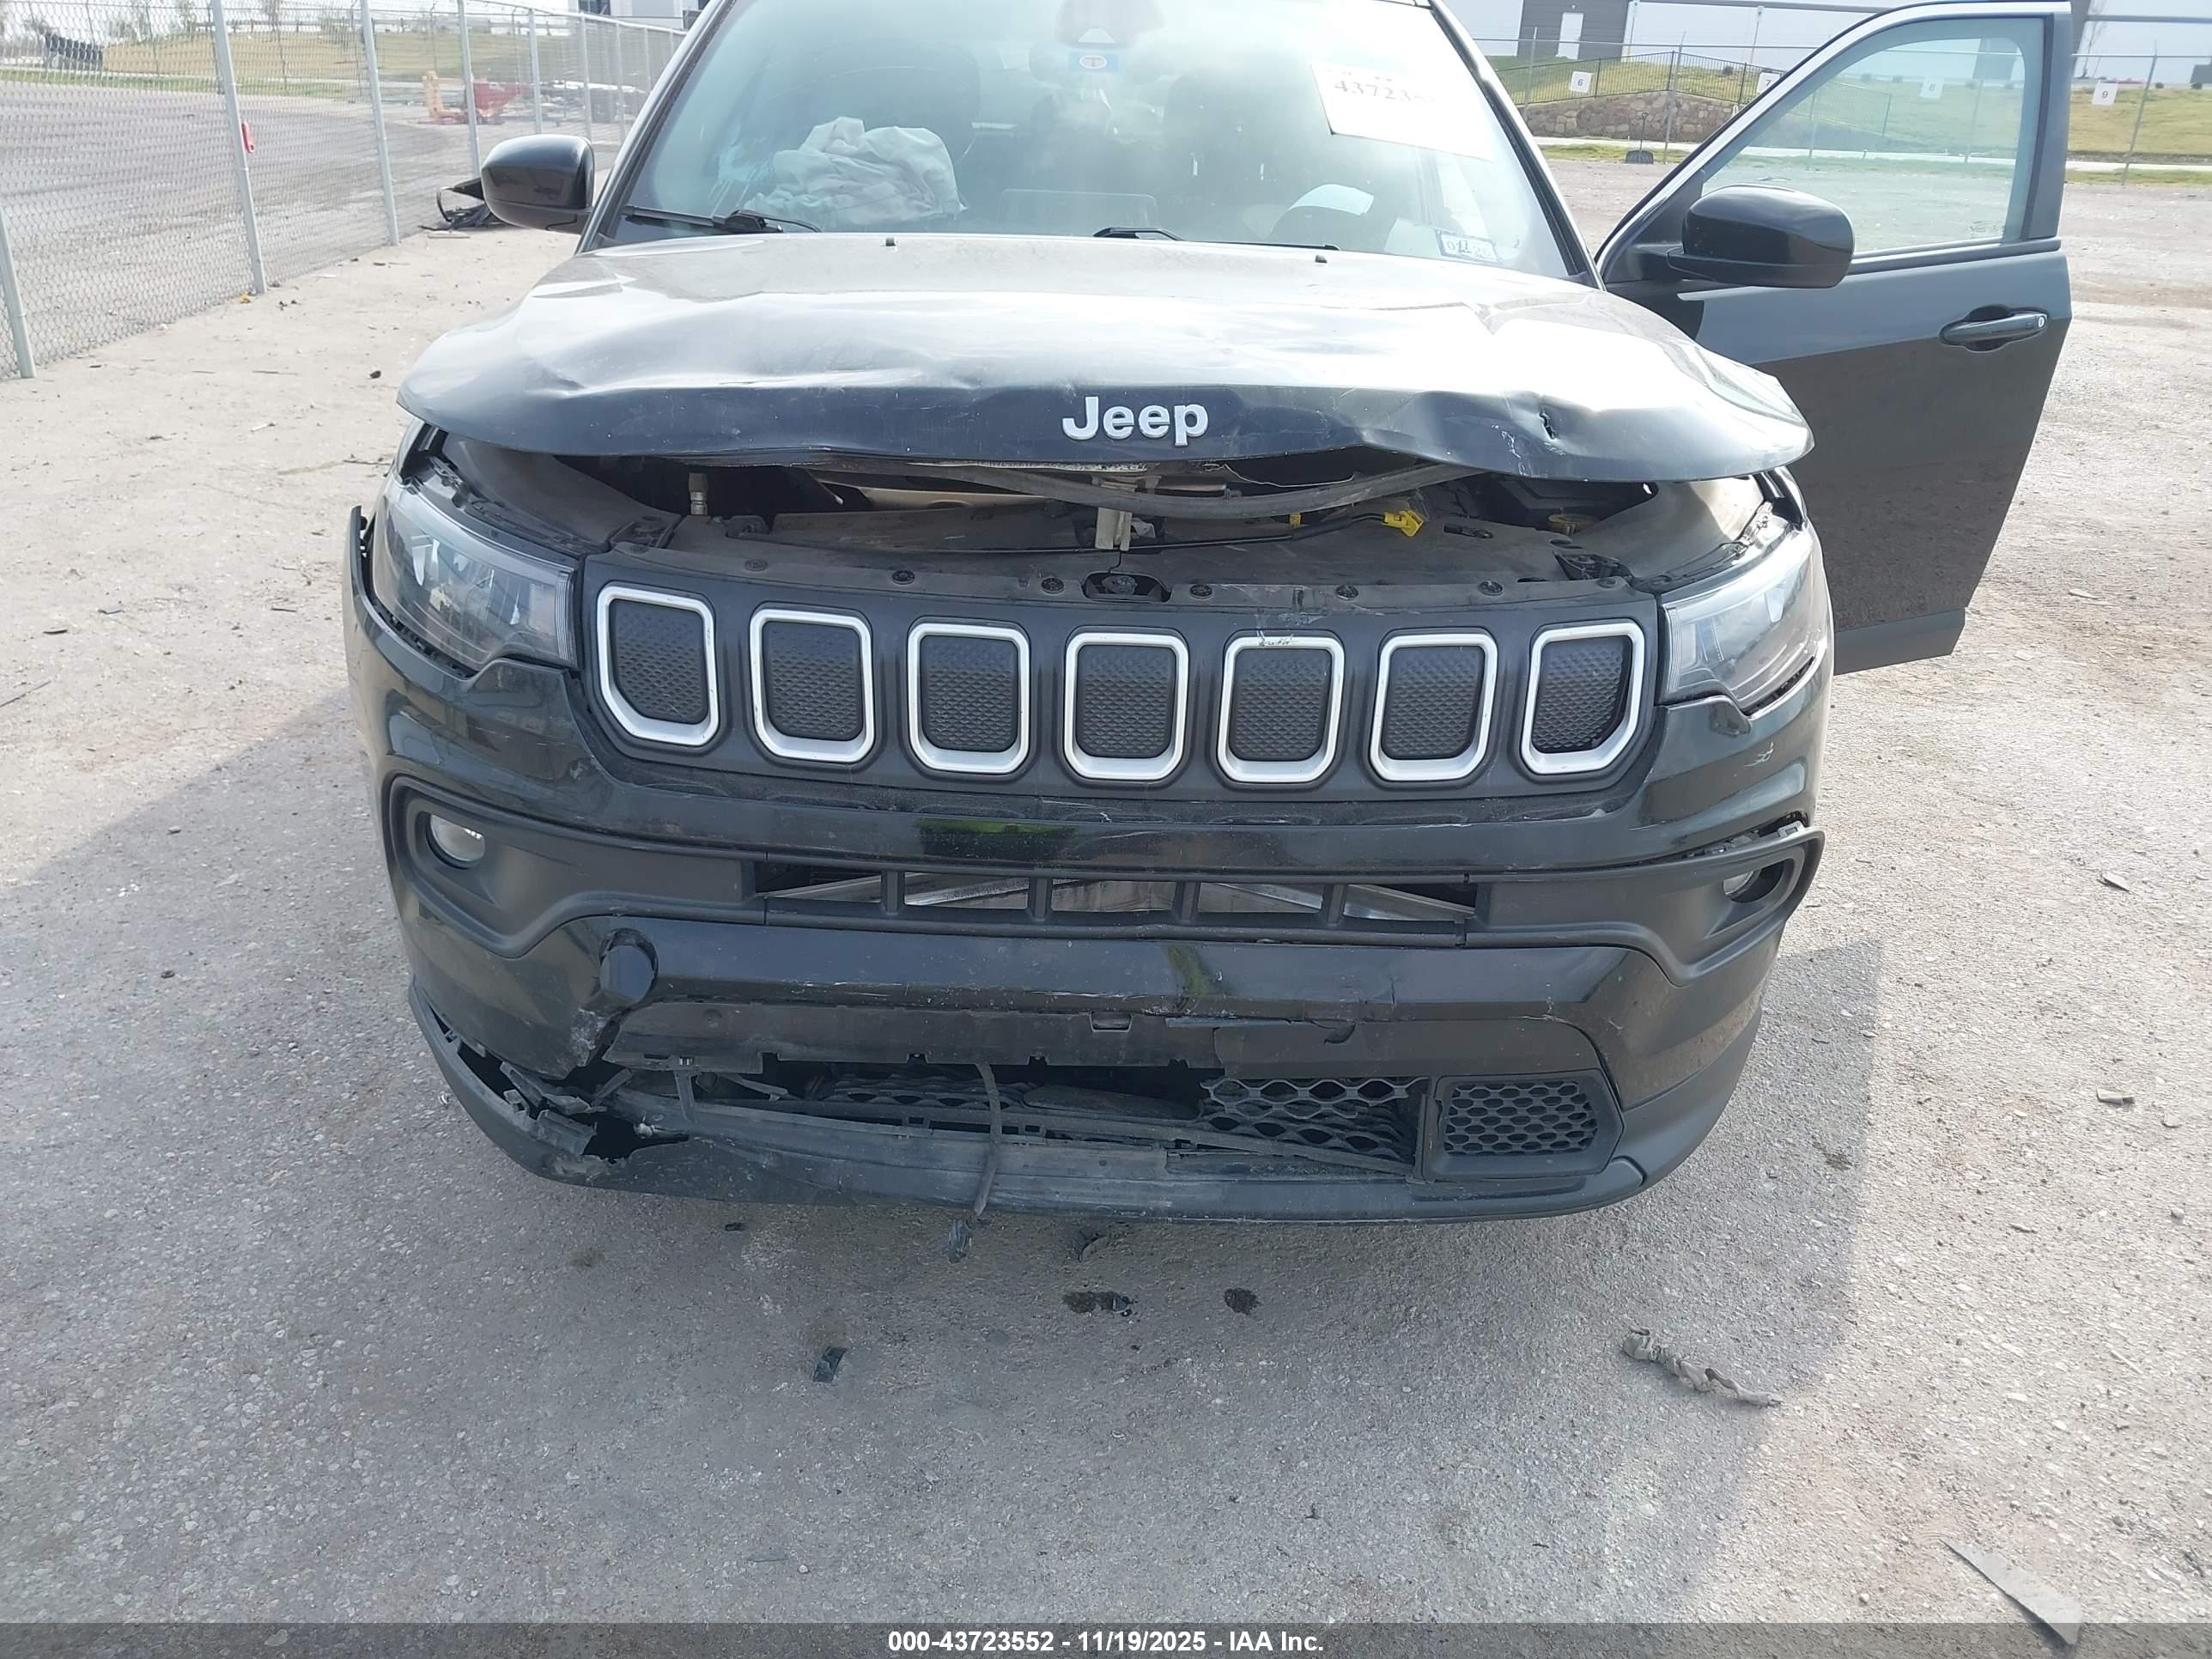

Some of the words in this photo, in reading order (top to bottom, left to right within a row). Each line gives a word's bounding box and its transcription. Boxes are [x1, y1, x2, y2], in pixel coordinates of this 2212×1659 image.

[1577, 78, 1584, 87] 6
[2101, 90, 2109, 99] 9
[1062, 396, 1208, 447] Jeep
